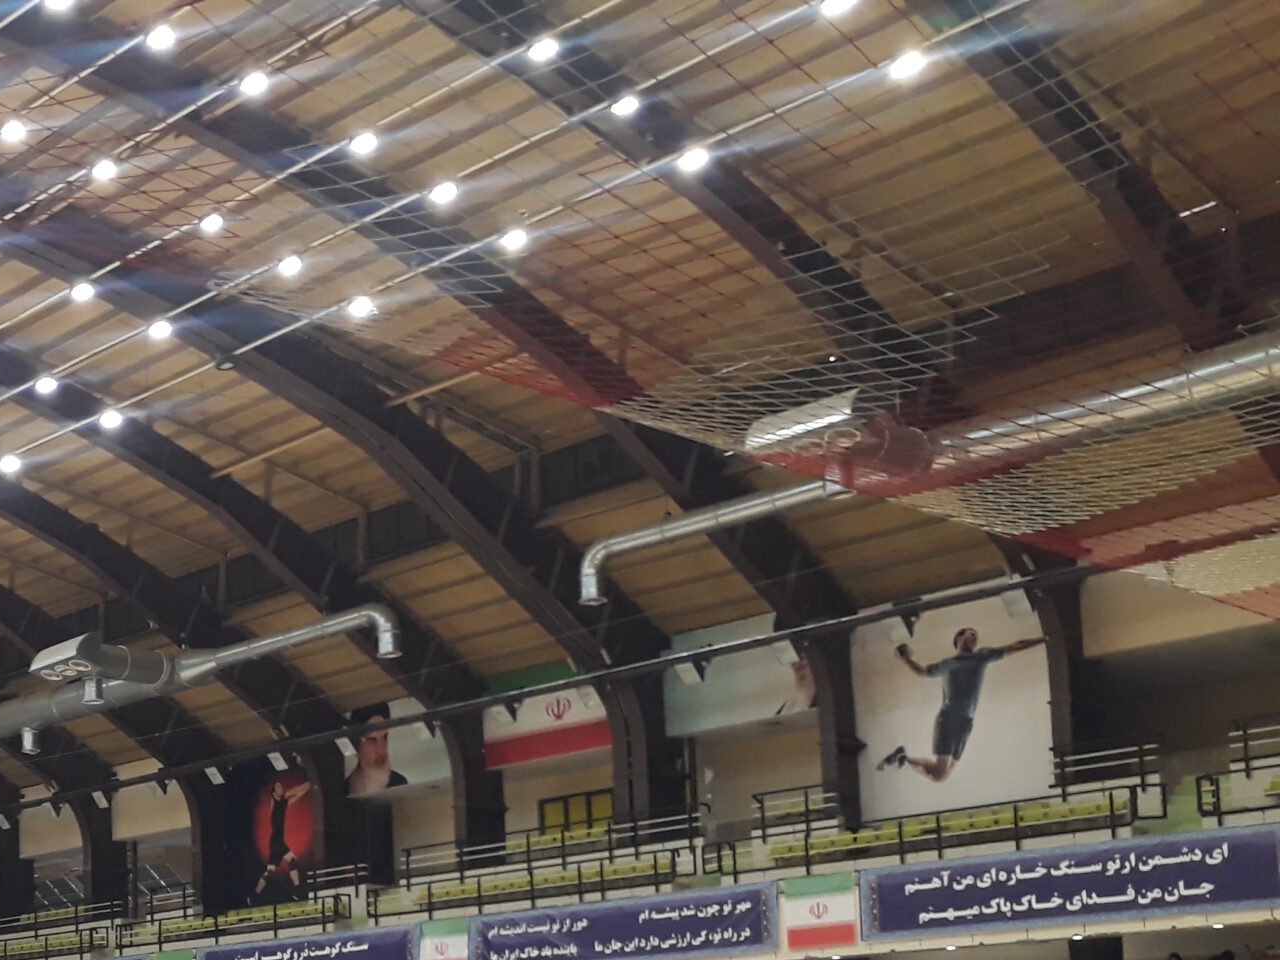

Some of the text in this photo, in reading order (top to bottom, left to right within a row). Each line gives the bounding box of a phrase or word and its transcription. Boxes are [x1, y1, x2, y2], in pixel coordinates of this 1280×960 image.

[1139, 846, 1203, 872] دشمن
[904, 869, 952, 896] آهنم
[952, 874, 975, 891] من
[918, 879, 1215, 925] جان من فدای خاک پاک میهنم
